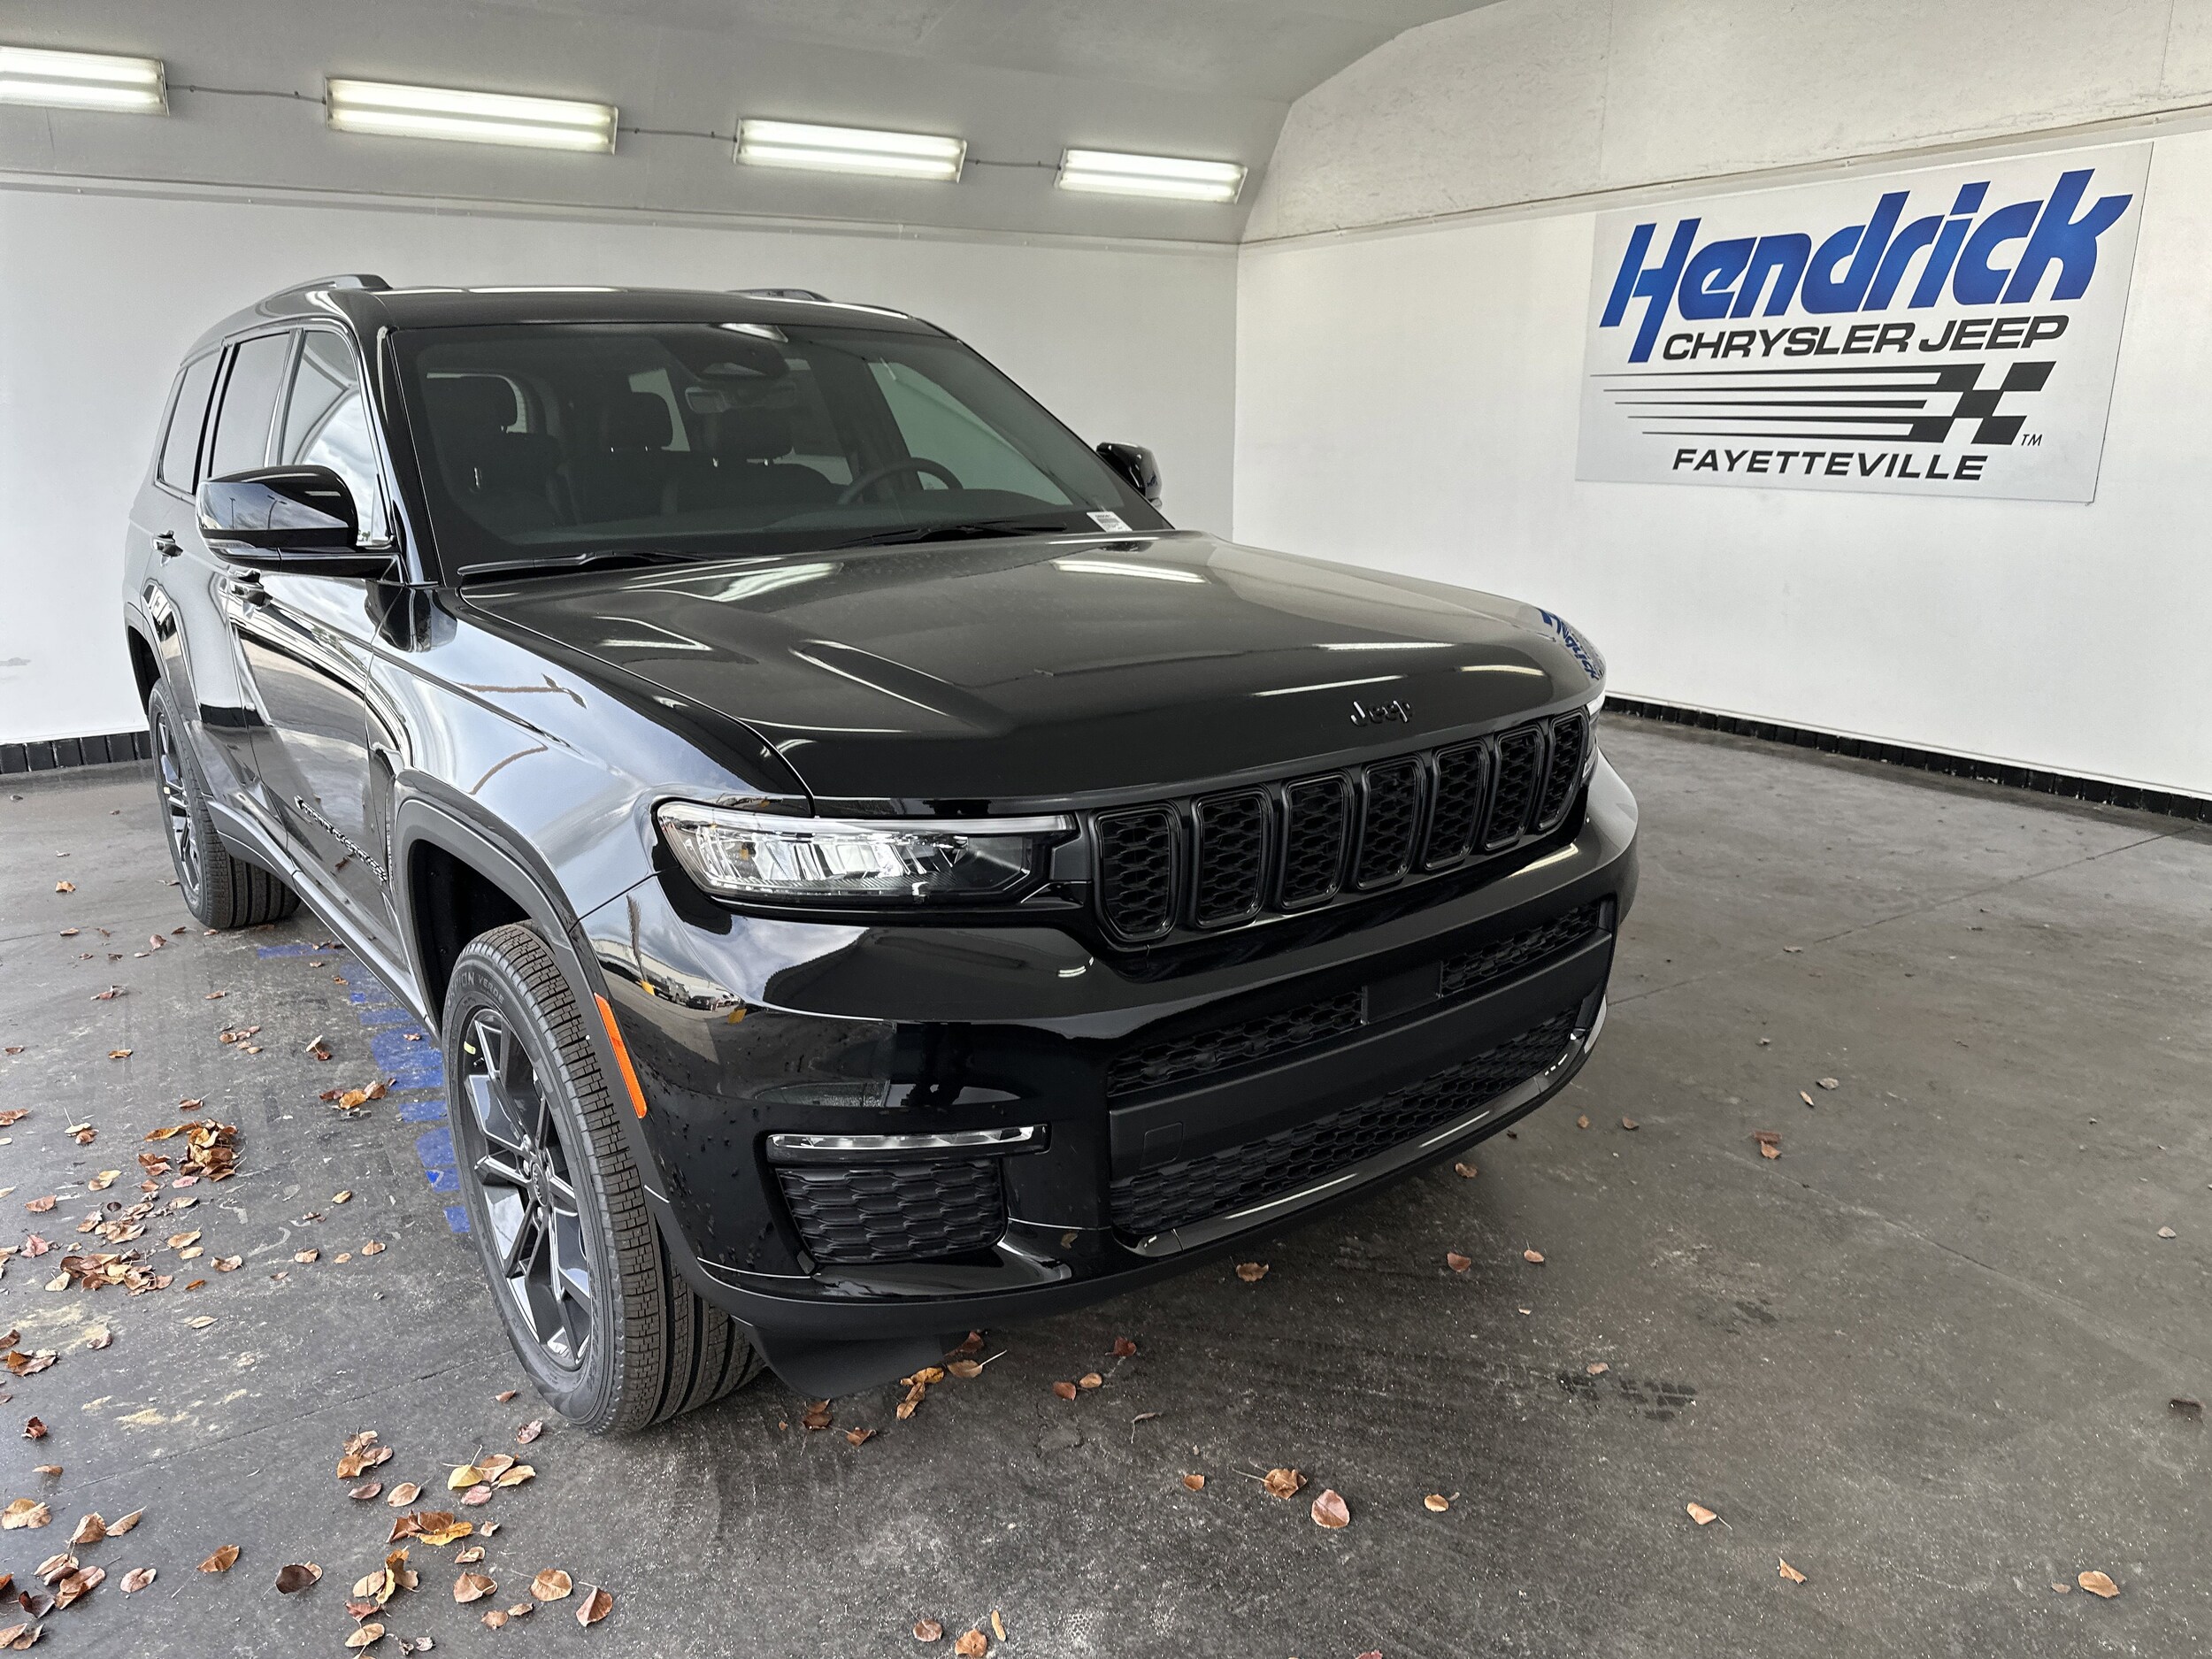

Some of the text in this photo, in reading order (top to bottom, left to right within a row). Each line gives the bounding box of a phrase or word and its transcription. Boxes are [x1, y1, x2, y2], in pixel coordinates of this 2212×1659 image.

[1599, 168, 2134, 364] Hendrick
[1663, 314, 2070, 360] CHRYSLER JEEP
[2021, 434, 2043, 447] TM
[1672, 449, 1989, 480] FAYETTEVILLE
[1350, 700, 1413, 726] Jeep
